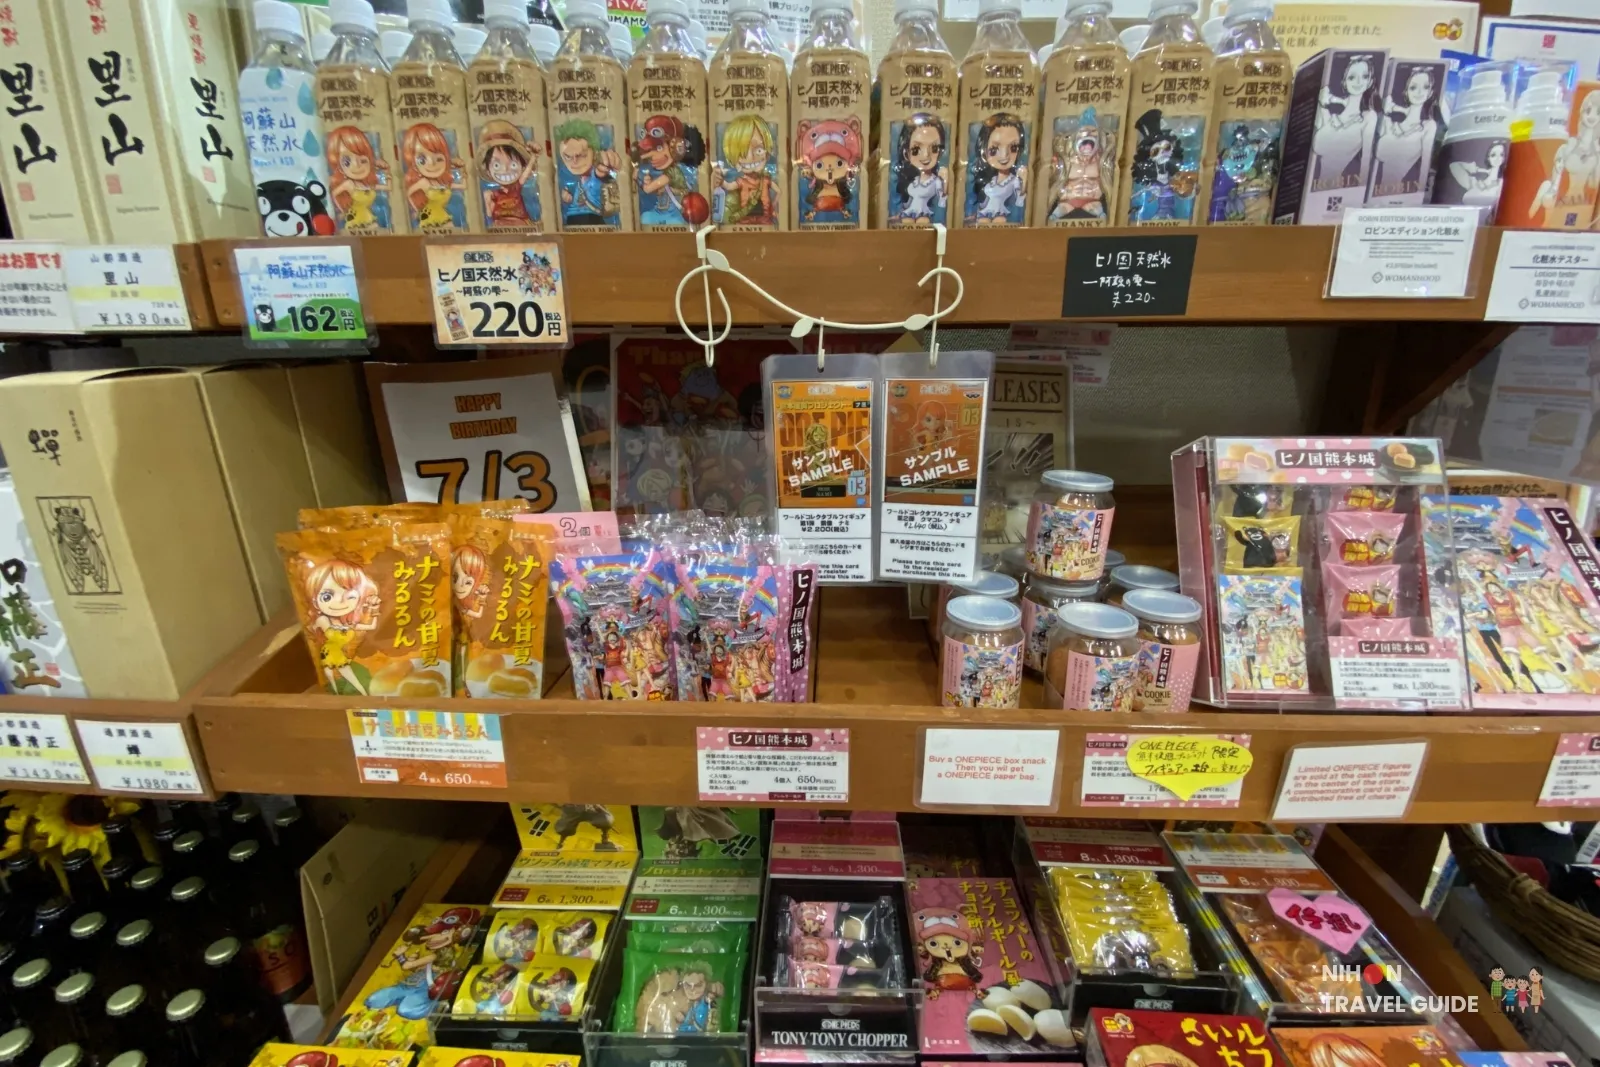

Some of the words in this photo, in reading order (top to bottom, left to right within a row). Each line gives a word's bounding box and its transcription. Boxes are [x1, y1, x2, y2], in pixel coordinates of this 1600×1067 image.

[1474, 113, 1507, 124] tester
[1096, 250, 1171, 270] ヒノ国天然水
[1532, 254, 1589, 264] 化粧水テスター
[103, 271, 139, 286] 里山
[438, 266, 518, 282] ヒノ国天然水
[287, 305, 339, 332] 162
[470, 301, 544, 337] 220
[545, 312, 562, 321] 税込
[548, 322, 561, 336] 円
[455, 393, 501, 413] HAPPY
[450, 417, 517, 439] BIRTHDAY
[791, 447, 841, 471] サンプル
[904, 446, 957, 470] サンプル
[1280, 452, 1376, 467] ヒノ国熊本城
[788, 457, 854, 487] SAMPLE
[899, 459, 970, 486] SAMPLE
[415, 450, 558, 513] 7/3
[1081, 556, 1101, 566] COOKIE
[393, 560, 416, 648] みるるん
[489, 556, 518, 643] みるるん
[415, 555, 443, 667] ナミの甘夏
[511, 555, 541, 666] ナミの甘夏
[791, 574, 810, 669] ヒノ国熊本城
[1361, 643, 1427, 653] ヒノ国熊本城
[1144, 690, 1172, 699] COOKIE
[732, 733, 807, 746] ヒノ国熊本城
[929, 755, 945, 763] Buy
[955, 756, 1001, 764] ONEPIECE
[1010, 765, 1024, 773] get
[1333, 764, 1380, 772] ONEPIECE
[445, 773, 472, 785] 650
[1103, 855, 1140, 863] 1,300
[848, 865, 878, 873] 1,300
[559, 895, 593, 904] 1,300
[959, 881, 984, 929] チョコ餅
[692, 906, 726, 916] 1,300
[993, 881, 1034, 961] チョッパーの
[975, 881, 1022, 987] ランブルボール風
[772, 1031, 808, 1045] TONY
[810, 1031, 848, 1046] TONY
[850, 1032, 908, 1048] CHOPPER
